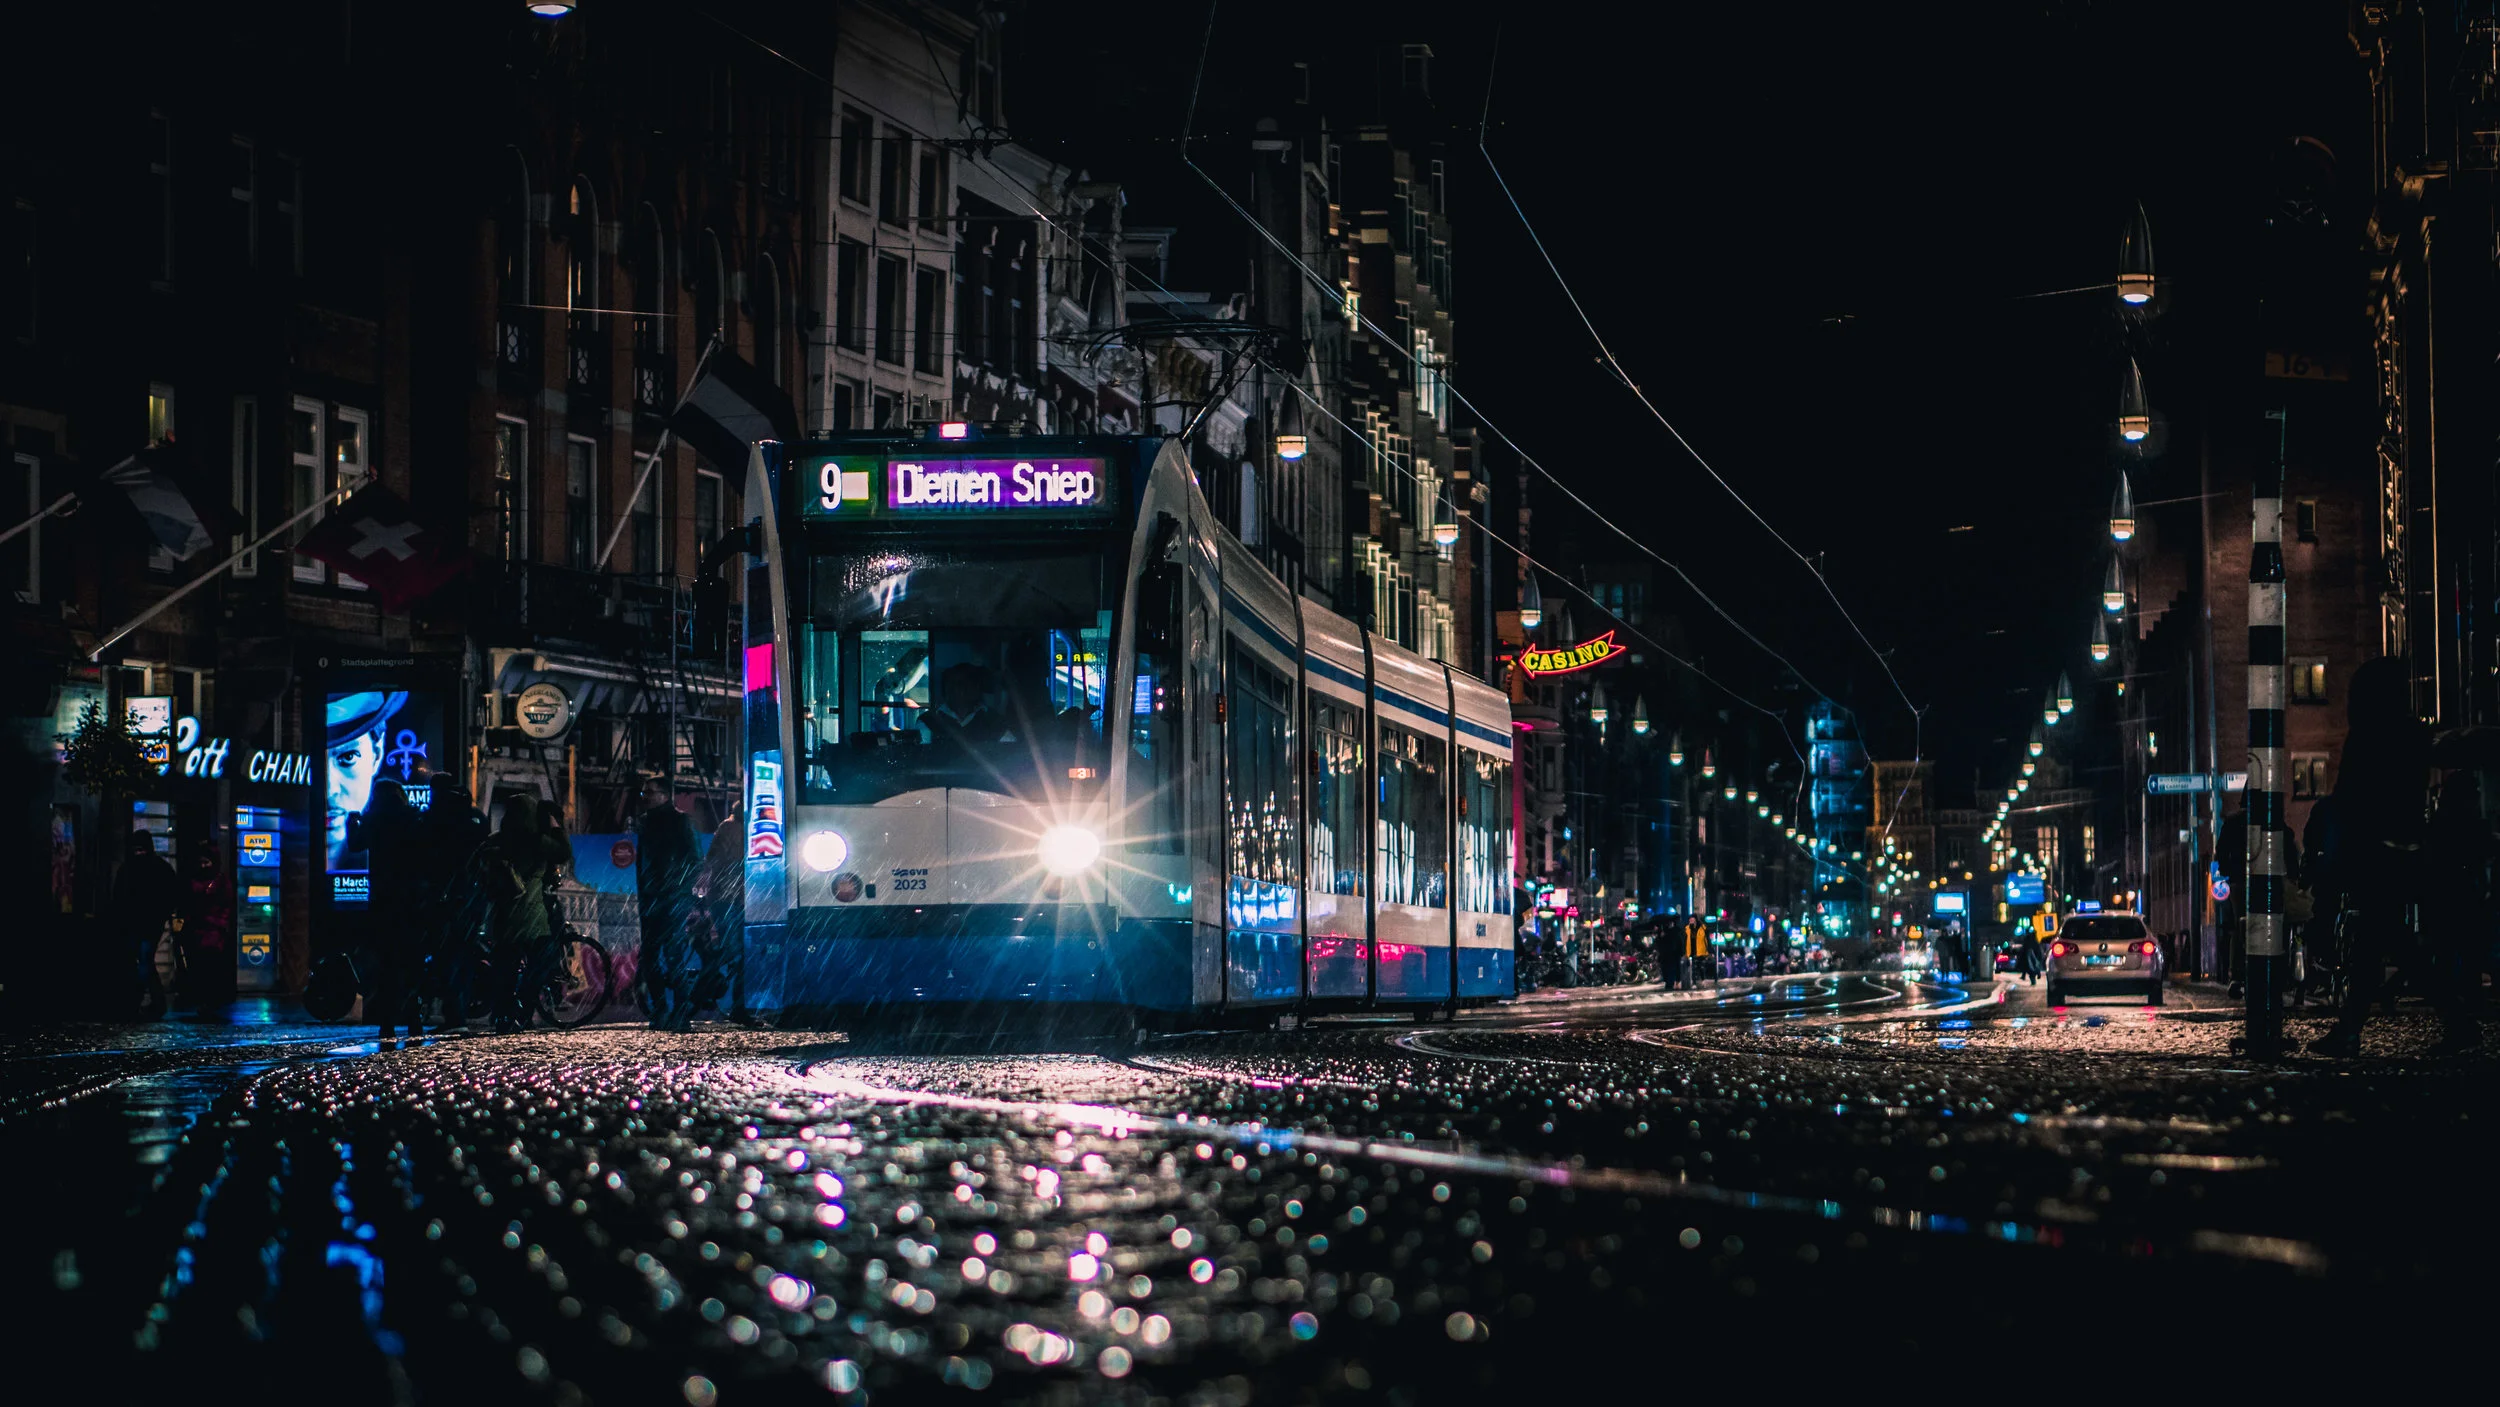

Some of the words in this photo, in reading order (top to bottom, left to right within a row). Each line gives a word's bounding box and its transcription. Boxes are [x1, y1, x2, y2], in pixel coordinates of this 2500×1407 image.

[821, 463, 841, 509] 9
[897, 464, 1000, 503] Diemen
[1013, 463, 1094, 505] Sniep
[1524, 640, 1609, 670] CASINO
[334, 876, 341, 887] 8
[342, 876, 369, 887] March
[894, 879, 927, 890] 2023
